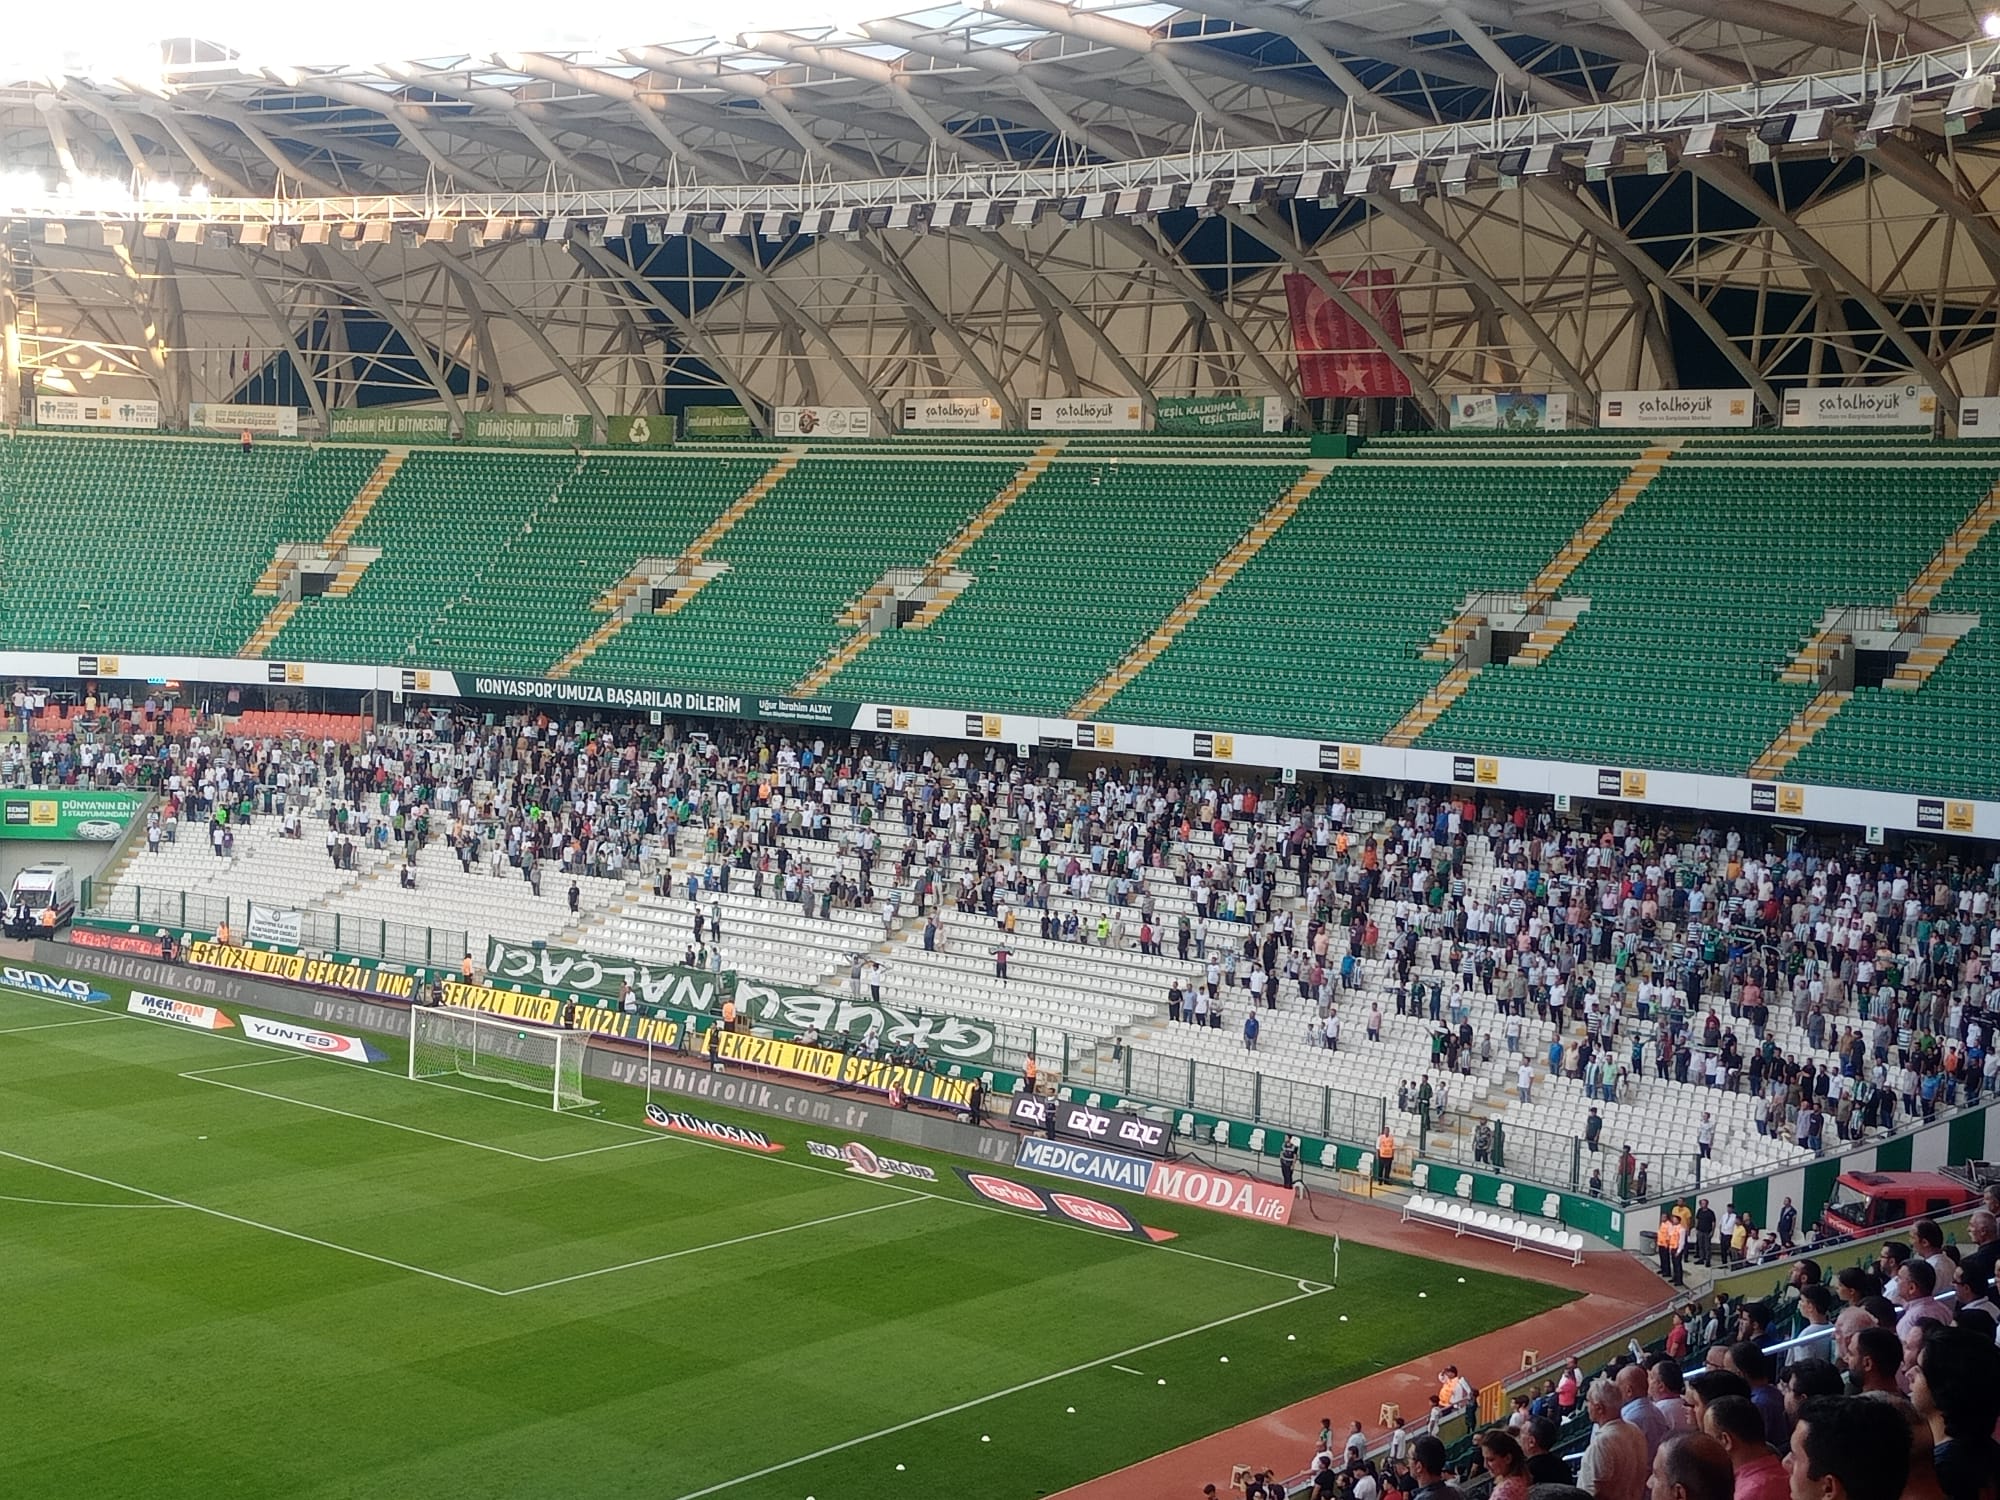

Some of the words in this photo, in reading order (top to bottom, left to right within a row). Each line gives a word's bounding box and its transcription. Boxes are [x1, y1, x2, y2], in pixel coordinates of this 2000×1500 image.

[1819, 393, 1901, 411] çatalhöyük
[1905, 385, 1916, 397] G
[1158, 405, 1184, 420] YEŞİL
[1186, 401, 1238, 416] KALKINMA
[1638, 395, 1713, 414] çatalhöyük
[333, 416, 375, 433] DOĞANIN
[378, 415, 396, 432] PİLİ
[398, 415, 448, 432] BİTMESİN!
[1199, 412, 1225, 426] YEŞİL
[1226, 408, 1261, 423] TRİBÜN
[478, 419, 532, 441] DÖNÜŞÜM
[534, 419, 580, 437] TRİBÜNÜ
[475, 678, 604, 703] KONYASPOR'UMUZA
[606, 687, 683, 709] BAŞARILAR
[685, 692, 741, 714] DİLERİM
[809, 704, 833, 715] ALTAY
[62, 800, 116, 810] DÜNYA'NIN
[117, 801, 131, 810] EN
[66, 951, 242, 998] uysalhidrolik.com.tr
[74, 993, 89, 1002] TV
[141, 995, 206, 1018] MEKPAN
[148, 1008, 192, 1023] PANEL
[254, 1023, 331, 1047] YUNTES
[716, 1033, 784, 1067] EKİZLİ
[612, 1060, 869, 1129] uysalhidrolik.com.tr
[668, 1113, 769, 1149] TÜMOSAN
[877, 1157, 934, 1180] GROUP
[975, 1179, 1034, 1205] Torku
[1151, 1166, 1255, 1216] MODA
[1254, 1196, 1286, 1221] Life
[1057, 1197, 1122, 1224] Torku
